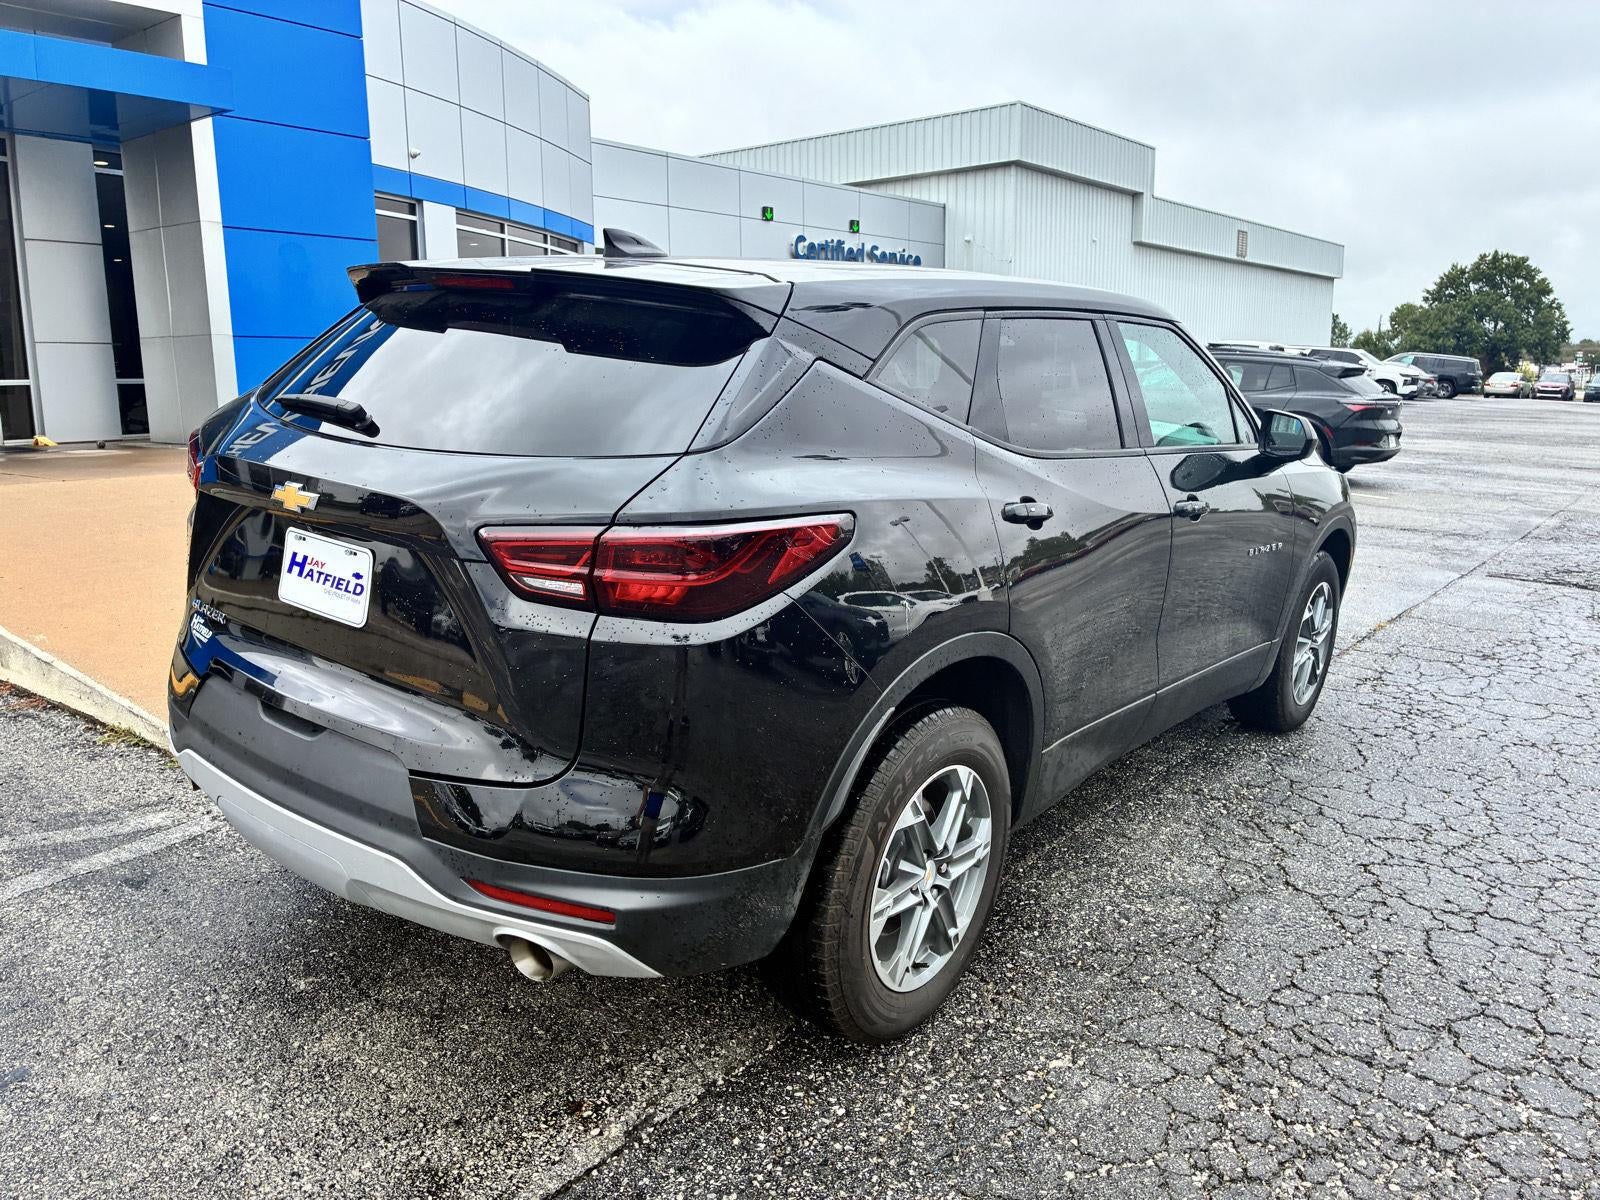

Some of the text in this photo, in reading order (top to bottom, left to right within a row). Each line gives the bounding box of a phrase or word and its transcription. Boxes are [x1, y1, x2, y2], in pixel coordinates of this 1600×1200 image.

[792, 234, 922, 266] Certified Service
[287, 551, 365, 596] HATFIELD
[306, 557, 326, 569] JAY
[192, 599, 227, 624] BLAZER
